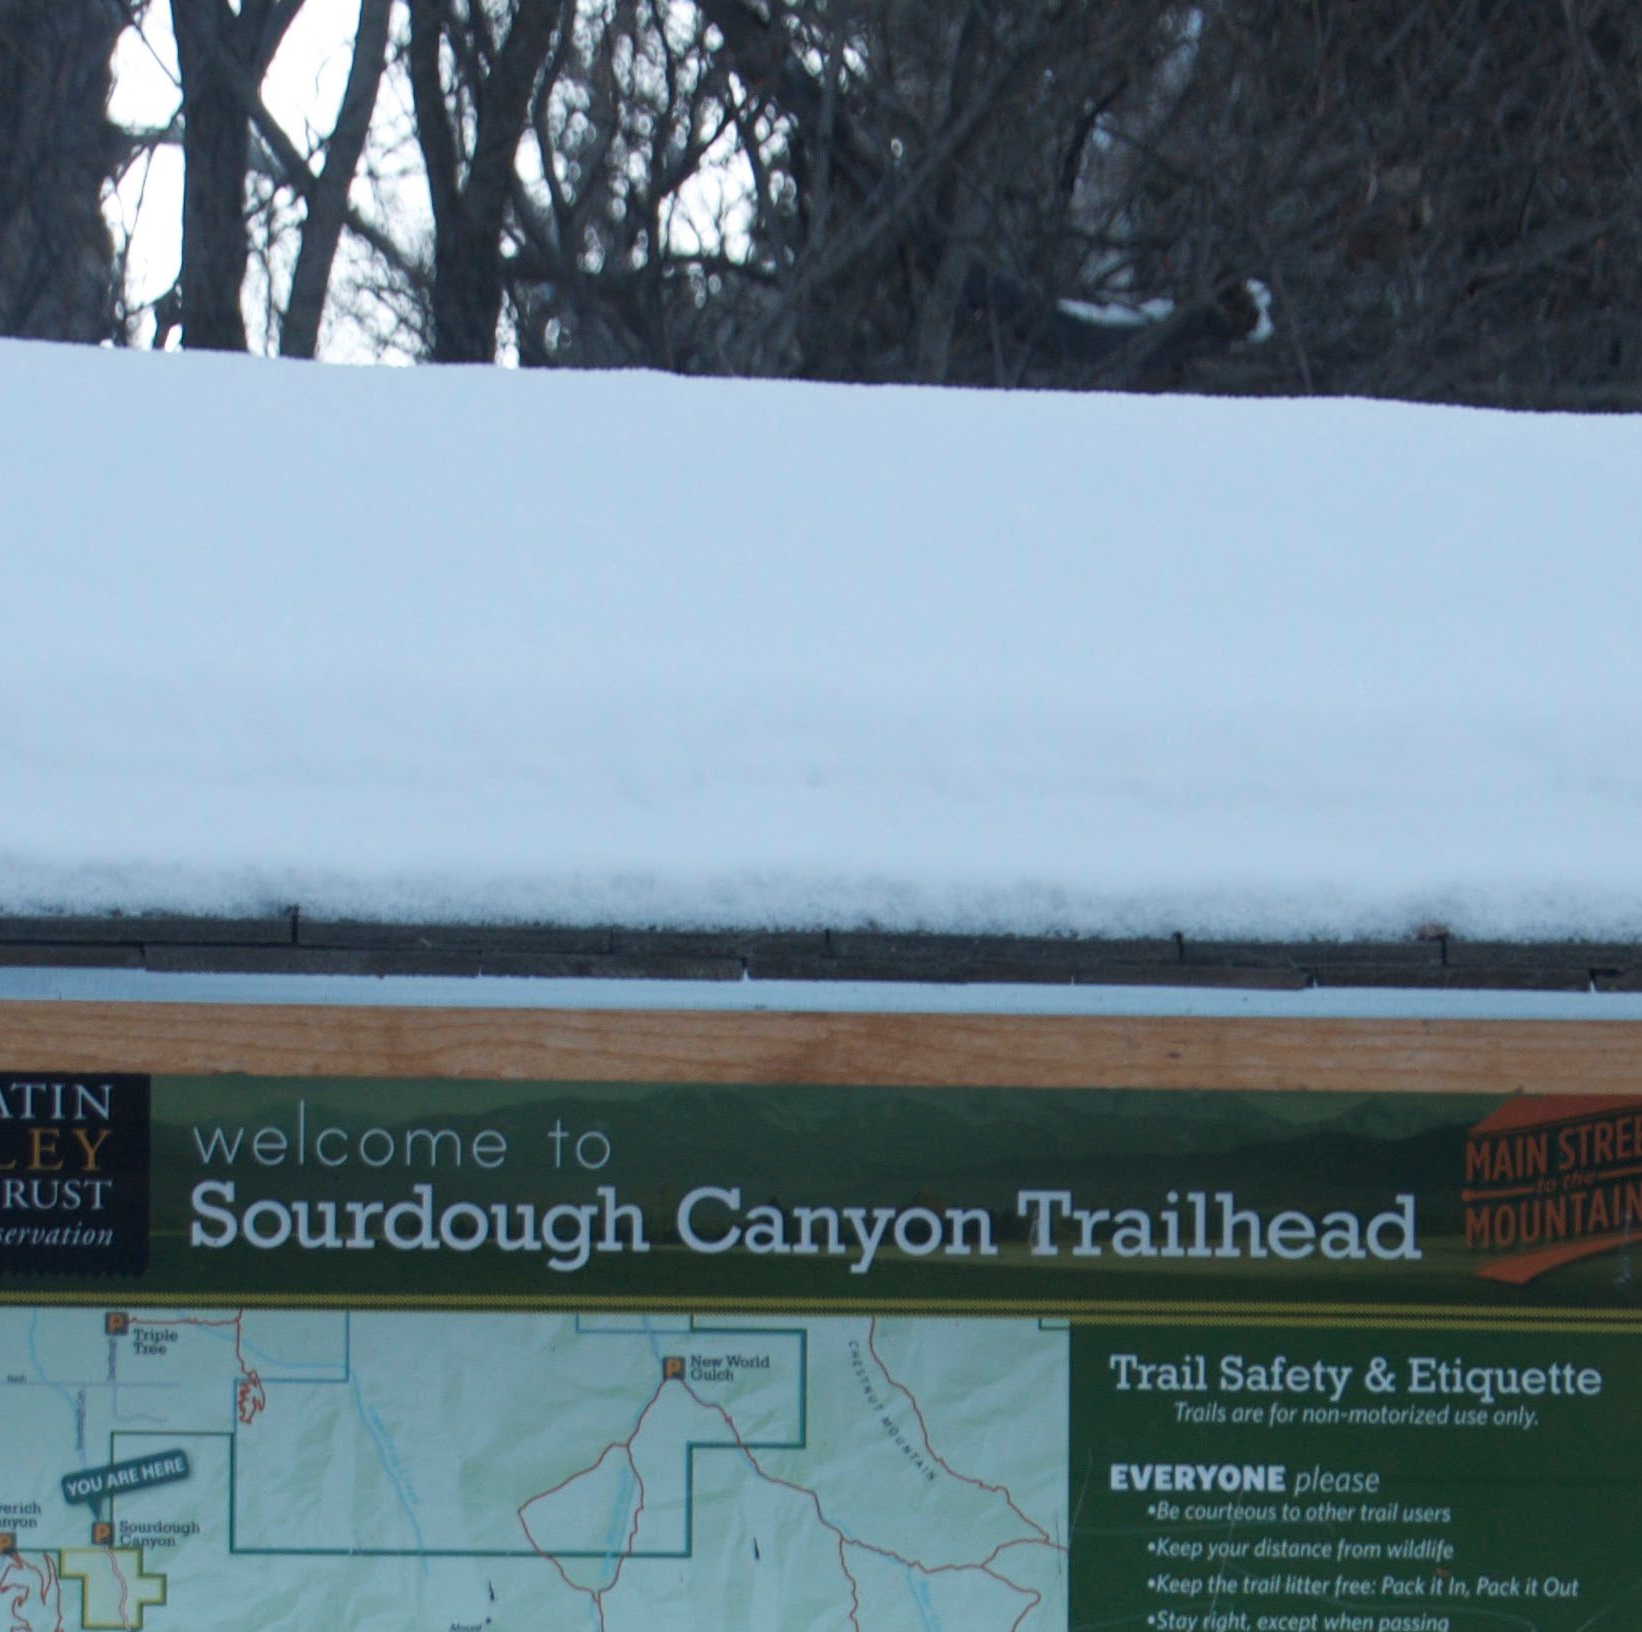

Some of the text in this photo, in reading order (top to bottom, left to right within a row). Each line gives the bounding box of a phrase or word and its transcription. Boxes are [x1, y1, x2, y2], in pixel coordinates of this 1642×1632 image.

[194, 1101, 611, 1169] welcome to
[1465, 1132, 1549, 1182] MAIN
[192, 1181, 1422, 1272] Sourdough Canyon Trailhead
[133, 1329, 178, 1346] Triple
[133, 1342, 167, 1355] Tree
[690, 1367, 734, 1381] Gulch
[691, 1355, 770, 1370] New World
[1110, 1354, 1602, 1403] Trail Safety & Etiquette
[1175, 1402, 1538, 1429] Trails are for non-motorized use only.
[66, 1458, 186, 1497] YOU ARE HERE
[1111, 1464, 1379, 1496] EVERYONE please
[120, 1522, 199, 1538] Sourdough
[121, 1535, 176, 1551] Canyon
